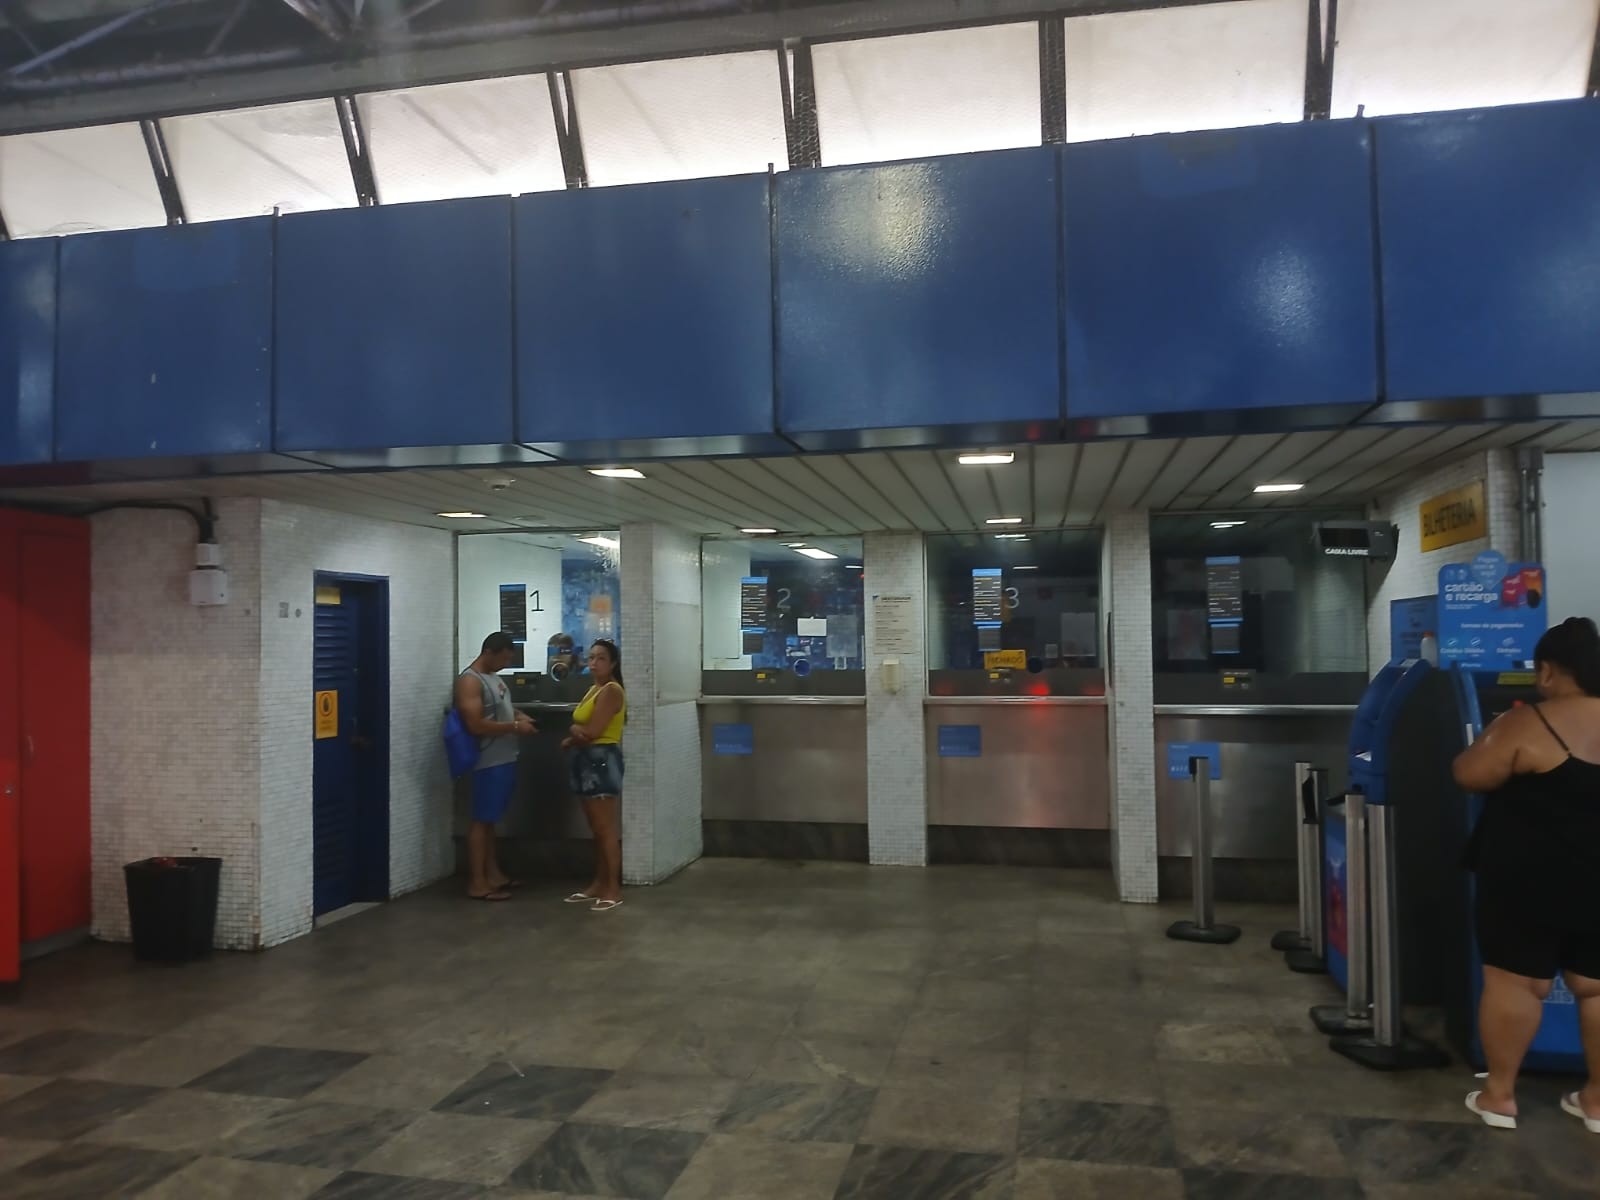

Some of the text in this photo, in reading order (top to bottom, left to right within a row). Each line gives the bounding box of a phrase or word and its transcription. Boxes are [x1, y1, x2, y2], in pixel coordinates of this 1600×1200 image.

[529, 590, 545, 612] 1
[776, 587, 792, 610] 2
[1004, 587, 1020, 609] 3
[1445, 592, 1499, 603] e recarga
